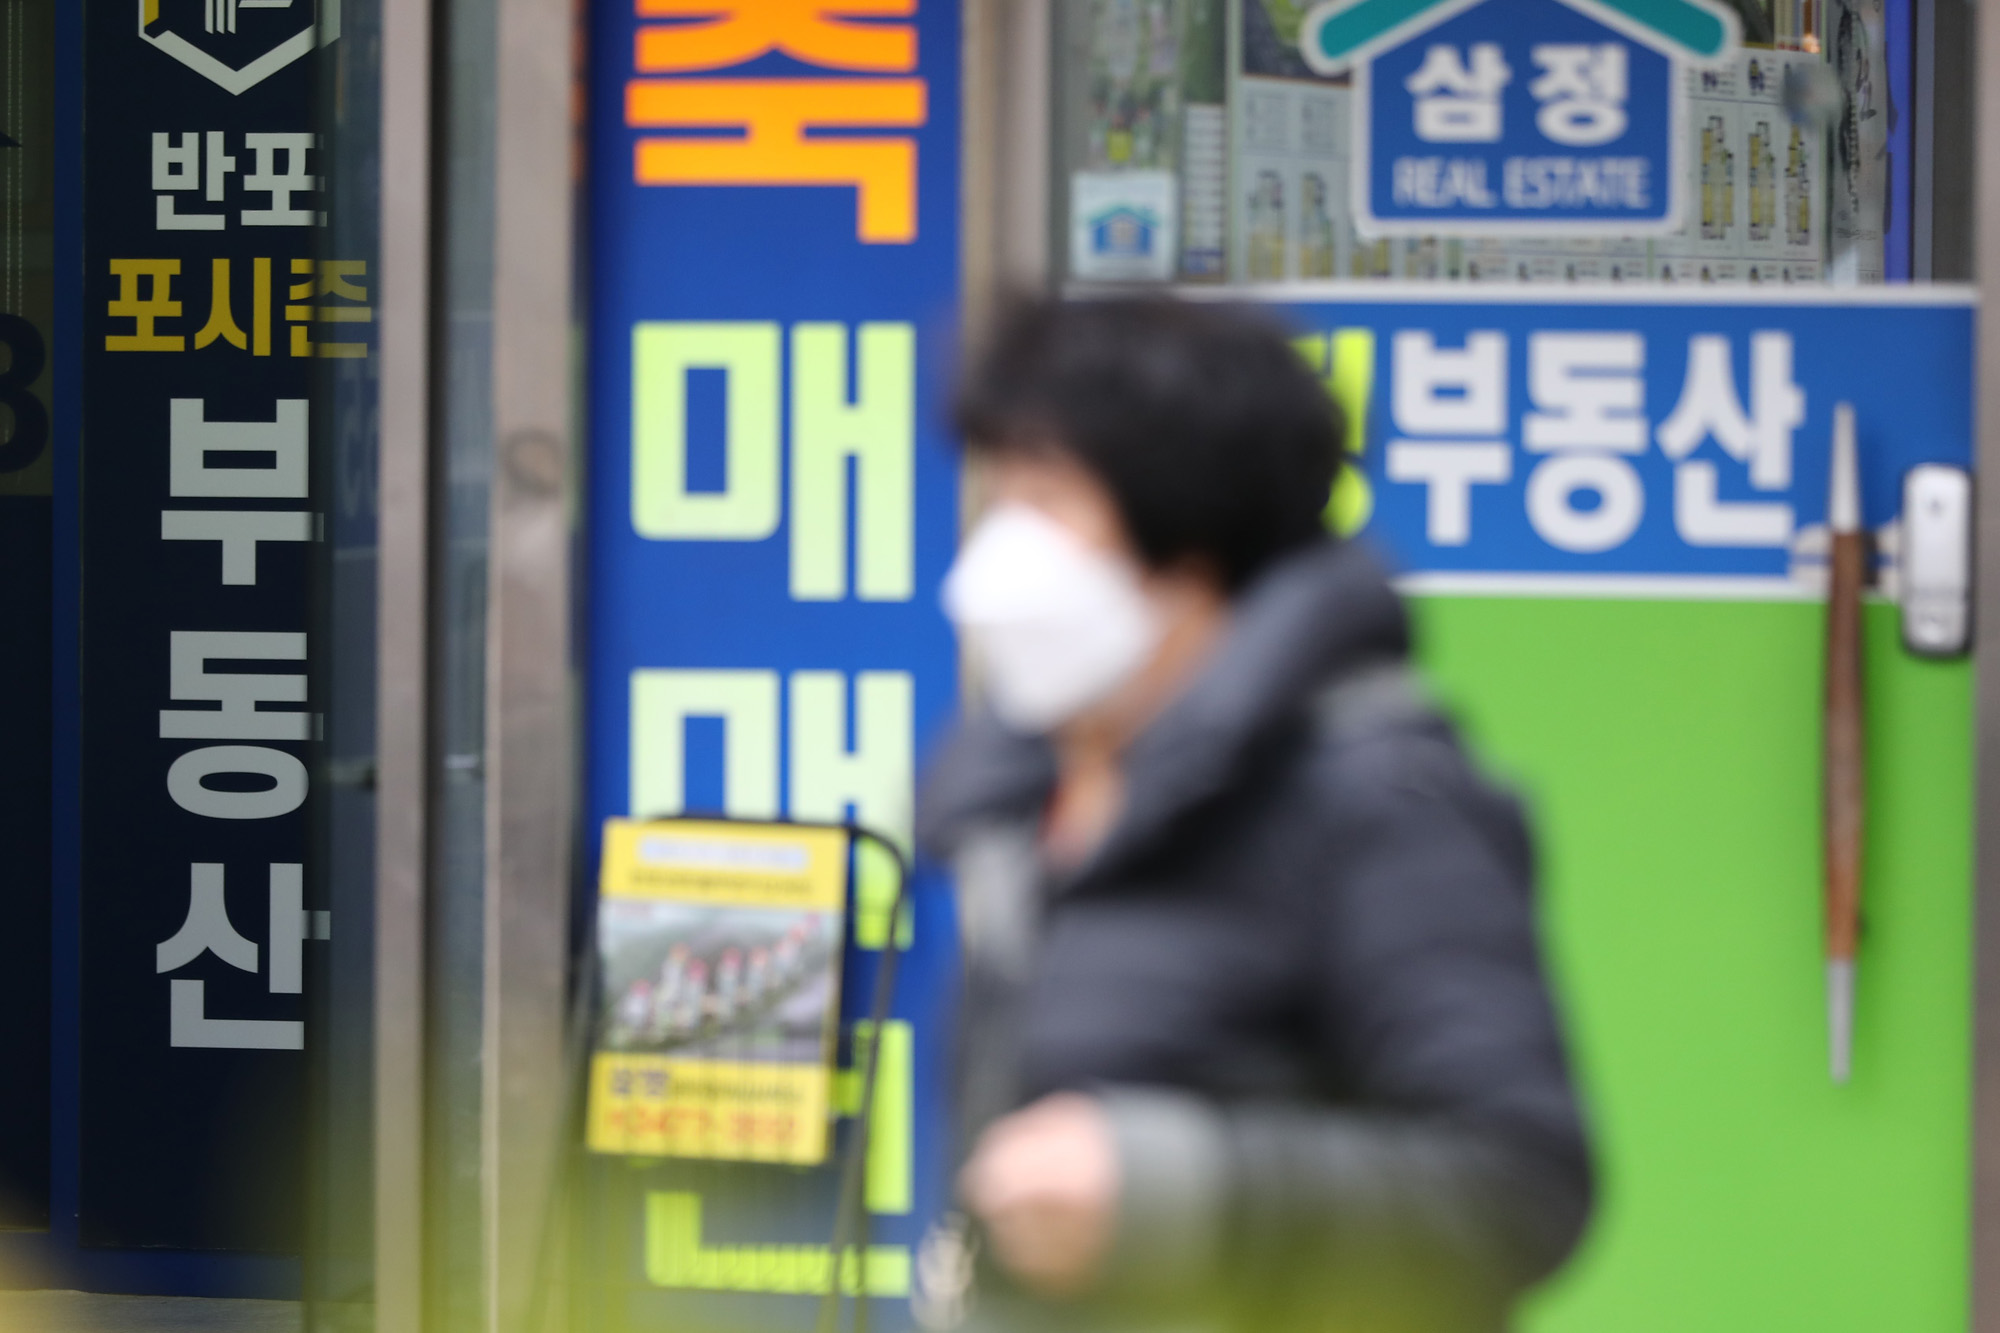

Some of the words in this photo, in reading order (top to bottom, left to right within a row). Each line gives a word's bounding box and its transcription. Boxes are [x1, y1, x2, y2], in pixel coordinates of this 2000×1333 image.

[1405, 42, 1632, 147] 삼정
[151, 130, 328, 231] 반포
[1392, 155, 1498, 210] REAL
[1503, 155, 1653, 210] ESTATE
[104, 257, 372, 359] 포시즌
[156, 397, 331, 1051] 부동산
